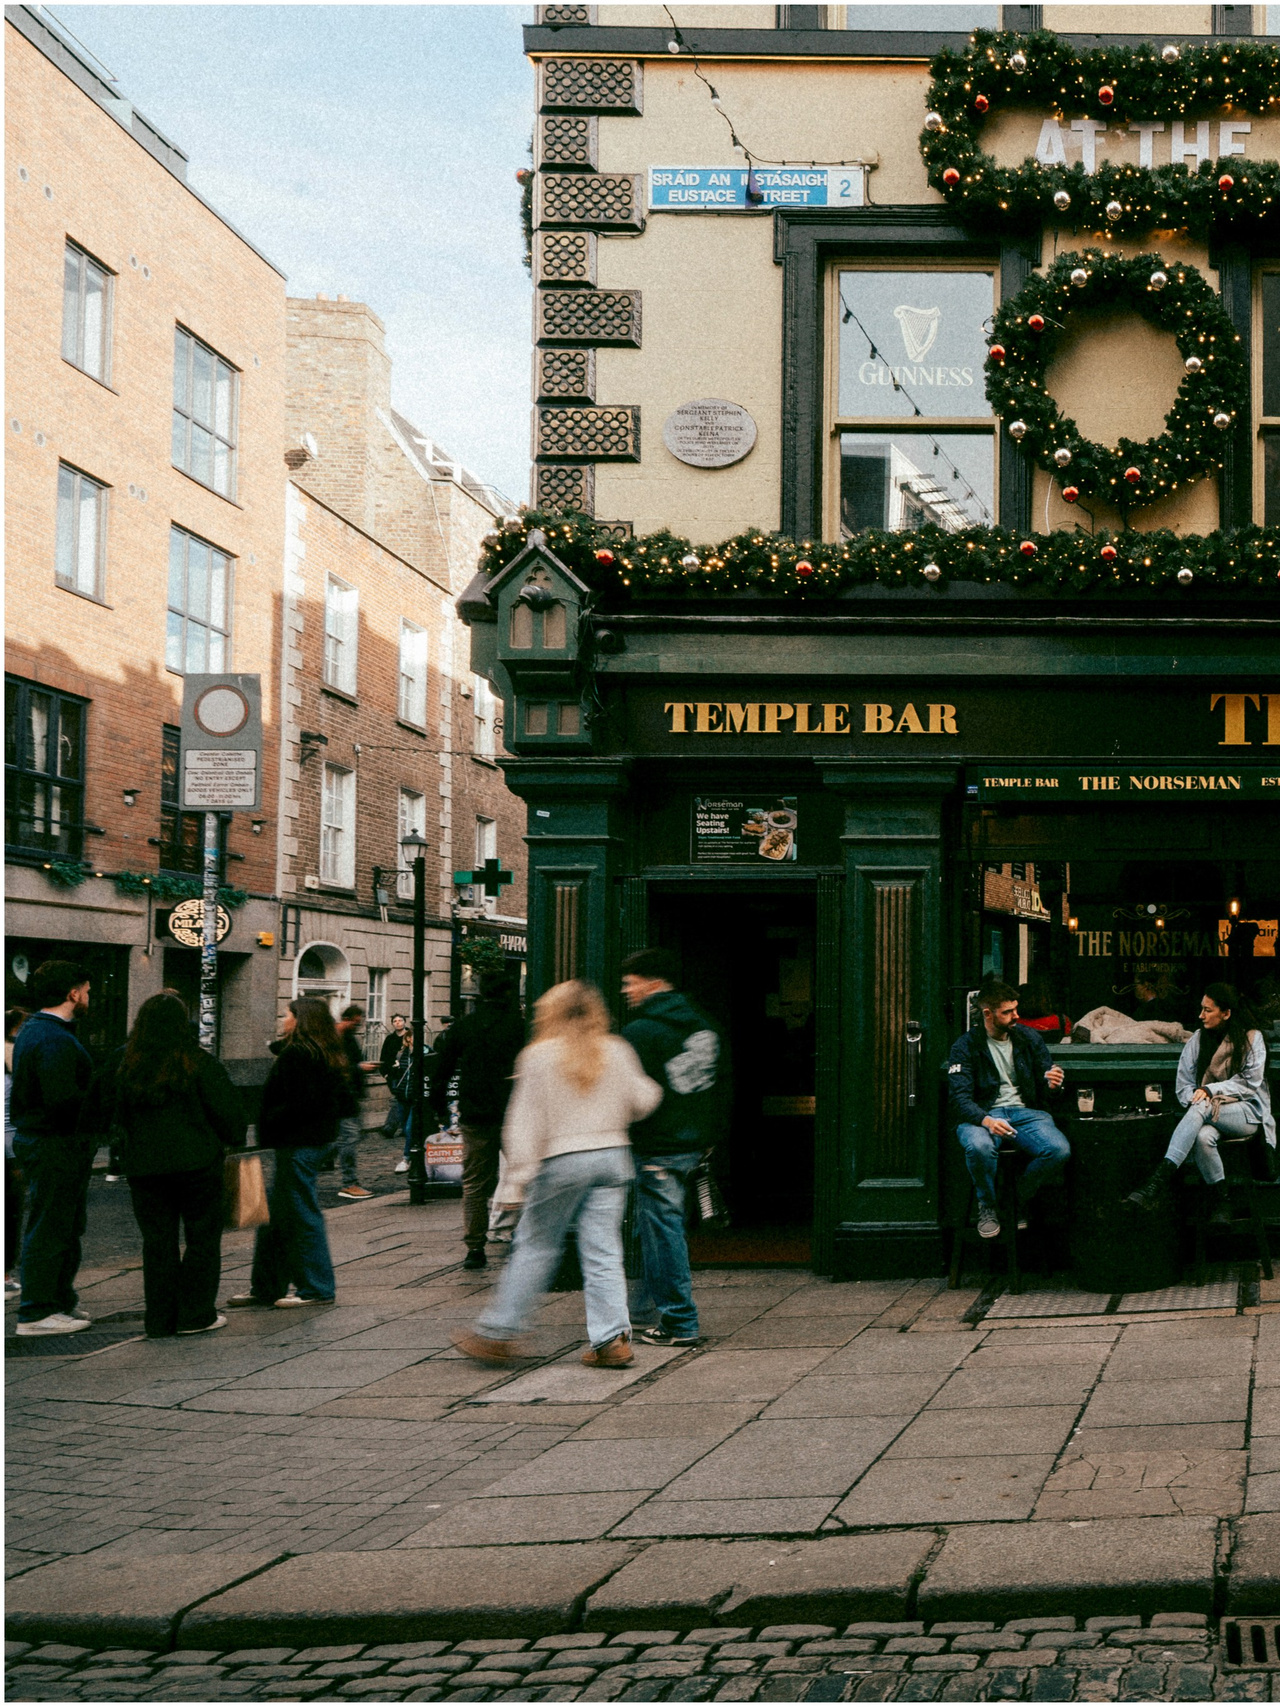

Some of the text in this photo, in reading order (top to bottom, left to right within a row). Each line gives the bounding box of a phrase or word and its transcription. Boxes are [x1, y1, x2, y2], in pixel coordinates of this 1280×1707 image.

[1035, 119, 1107, 176] AT
[1128, 121, 1252, 172] THE
[652, 170, 828, 186] SRÁID AN ISTÁSAIGH
[668, 190, 810, 202] EUSTACE TREET
[840, 179, 850, 198] 2
[859, 362, 974, 387] GUINNESS
[664, 702, 959, 734] TEMPLE BAR
[983, 777, 1032, 788] TEMPLE
[1035, 777, 1059, 788] BAR
[1078, 776, 1120, 790] THE
[1129, 776, 1241, 790] NORSEMAN
[696, 827, 729, 835] Upstairs!
[174, 919, 224, 928] MILAO
[1075, 931, 1112, 956] THE
